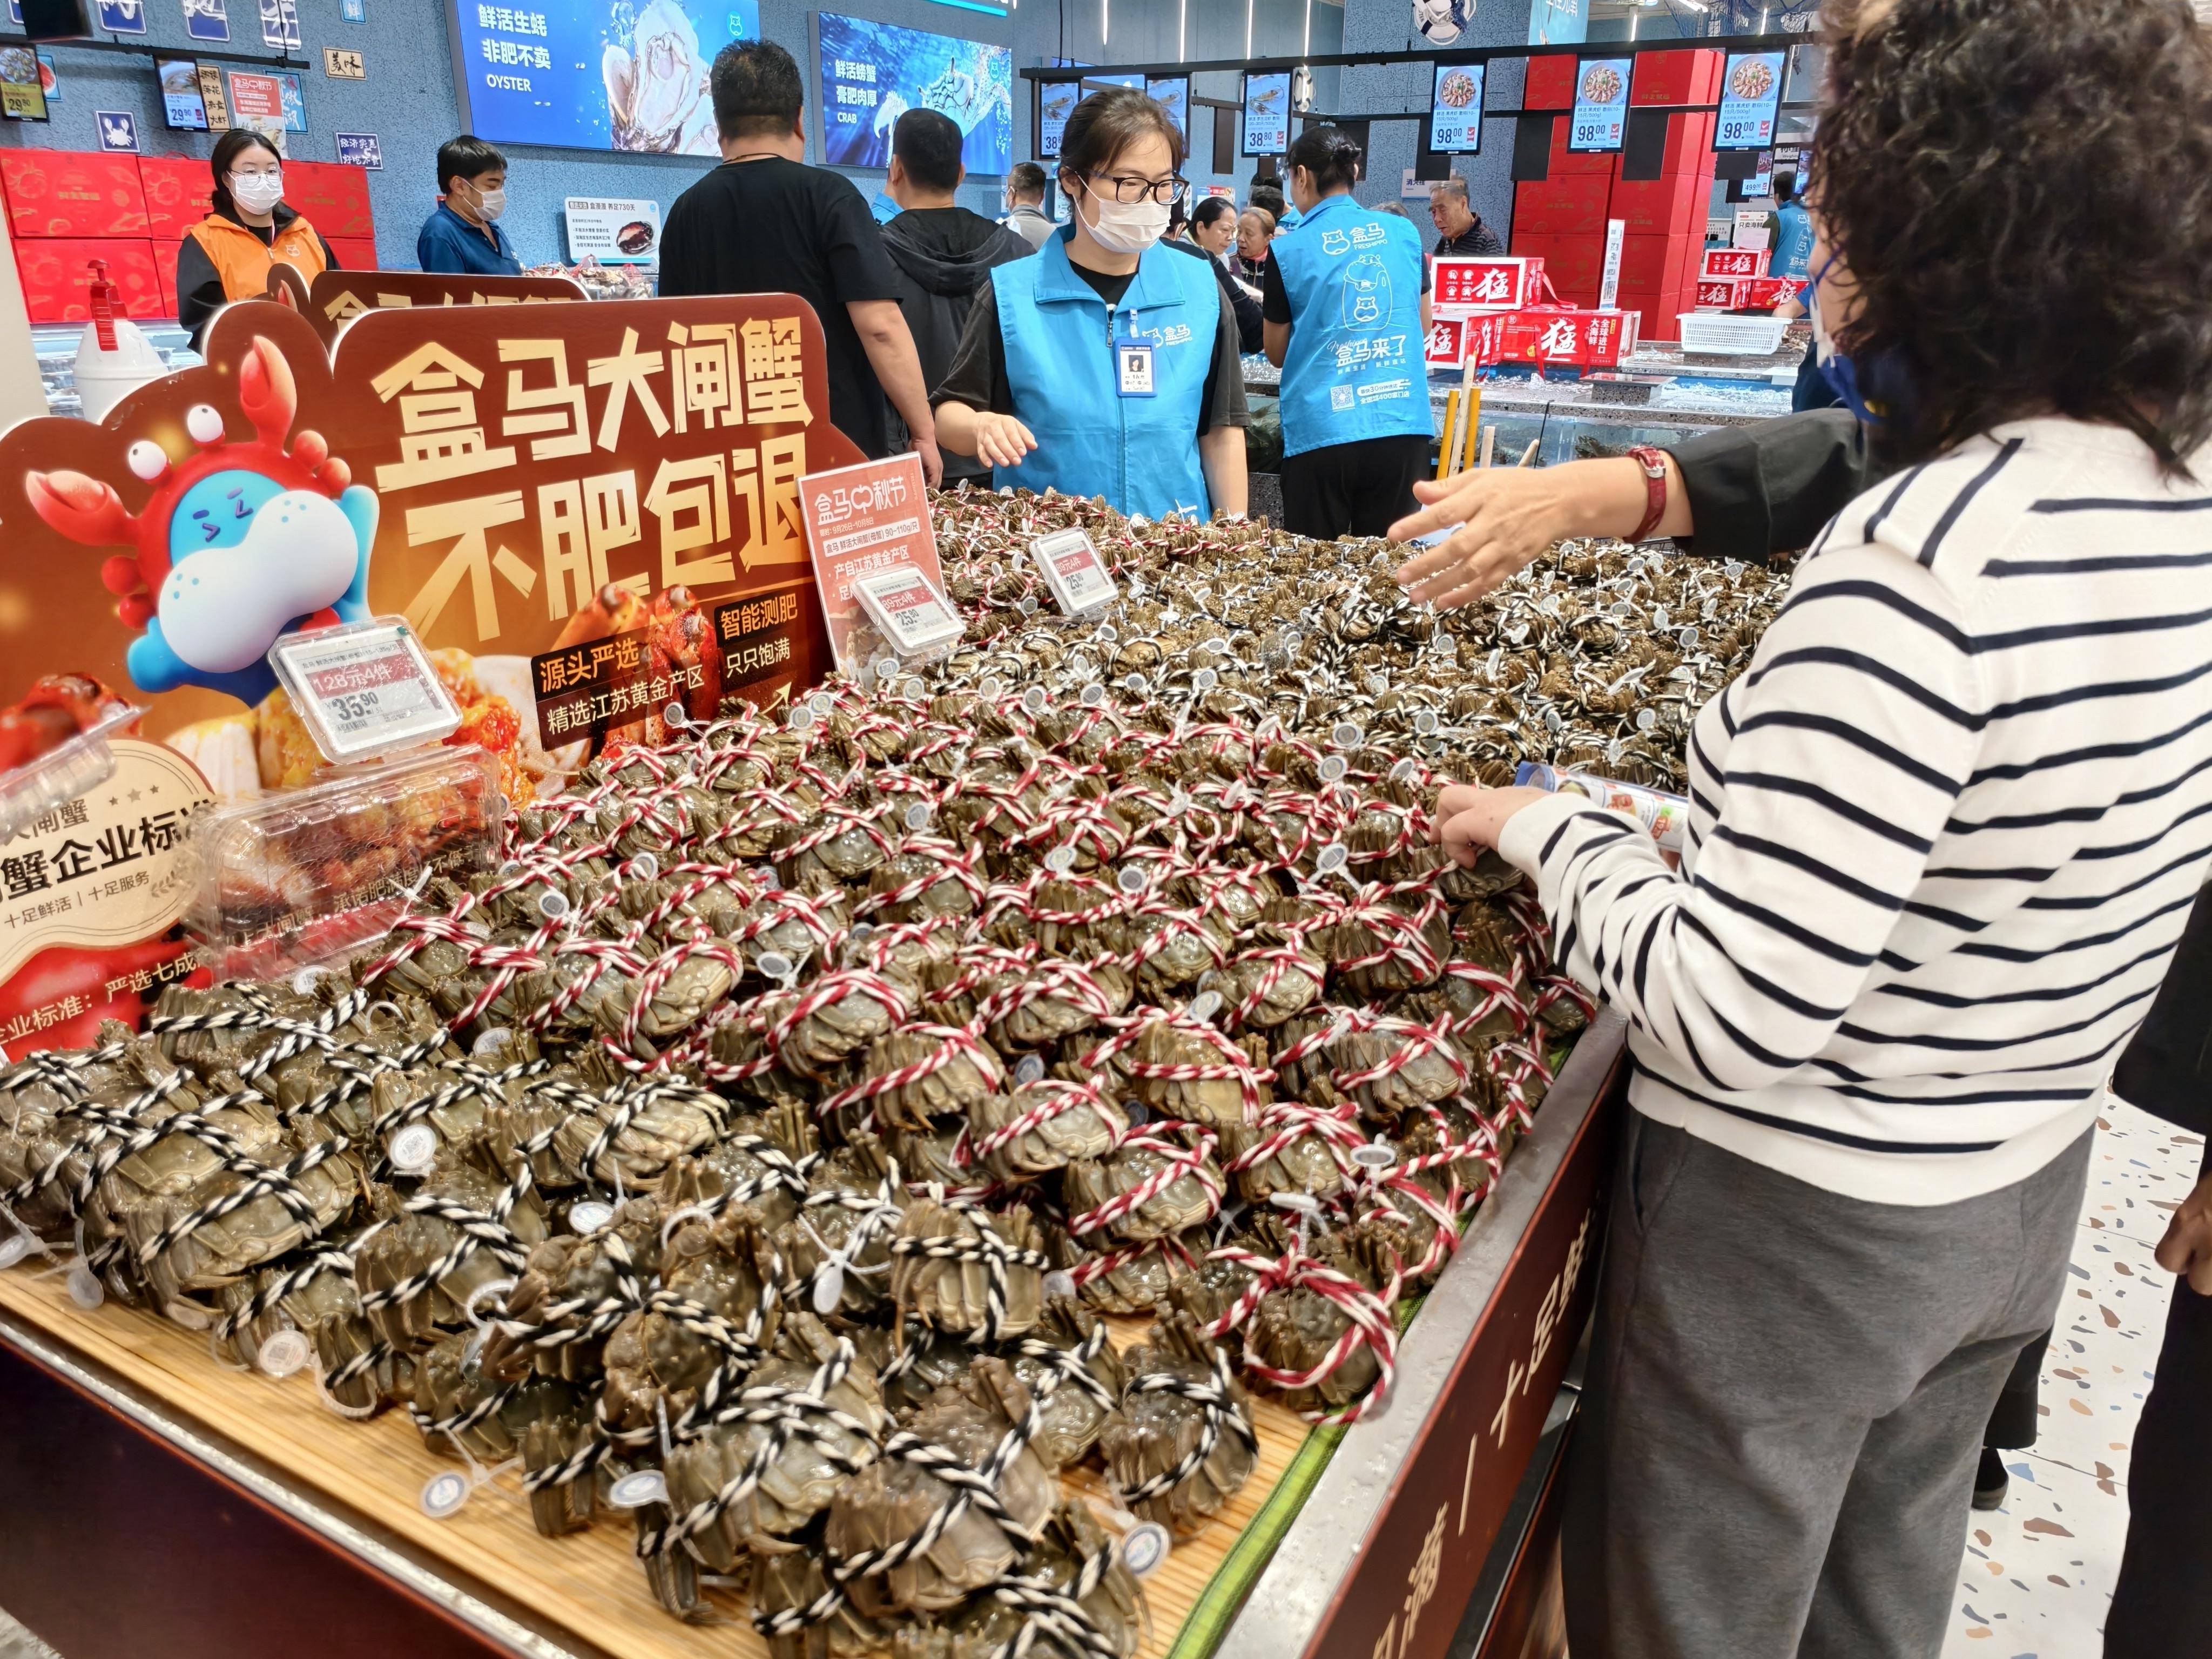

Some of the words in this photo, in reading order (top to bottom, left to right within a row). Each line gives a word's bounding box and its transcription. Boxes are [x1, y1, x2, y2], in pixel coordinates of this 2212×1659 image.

[478, 4, 547, 37] 鲜活生蚝
[331, 51, 362, 76] 美味
[482, 38, 551, 69] 非肥不卖
[487, 73, 532, 92] OYSTER
[835, 59, 876, 83] 鲜活螃蟹
[837, 85, 877, 107] 膏肥肉厚
[838, 112, 857, 124] CRAB
[1250, 132, 1272, 147] 38.80
[1437, 128, 1462, 144] 98.00
[1577, 125, 1606, 141] 98.00
[1723, 122, 1755, 139] 98.00
[340, 138, 377, 149] 经济实惠
[1046, 136, 1062, 150] 38.8
[342, 154, 379, 165] 好吃不贵
[1350, 222, 1385, 243] 盒马
[1354, 239, 1387, 250] FRESHIPPO
[1729, 254, 1752, 274] 猛
[1472, 268, 1510, 304] 猛
[1163, 324, 1190, 342] 盒马
[1541, 319, 1578, 358] 猛
[1589, 319, 1600, 345] 大海鲜
[1598, 319, 1610, 354] 全球进口
[1336, 335, 1406, 367] 盒马来了
[371, 316, 814, 494] 盒马大闸蟹
[814, 476, 906, 525] 盒马中秋节
[403, 432, 812, 647] 不肥包退
[826, 542, 839, 554] 盒马
[834, 544, 910, 579] 产自江苏黄金产区
[1055, 556, 1081, 572] 89元4件
[839, 585, 853, 602] 足
[882, 591, 916, 610] 89元4件
[720, 593, 798, 639] 智能测肥
[541, 637, 640, 693] 源头严选
[726, 638, 791, 678] 只只饱满
[313, 663, 392, 692] 128元4件
[547, 664, 705, 736] 精选江苏黄金产区
[15, 798, 90, 840] 闸蟹
[0, 799, 216, 903] 蟹企业标
